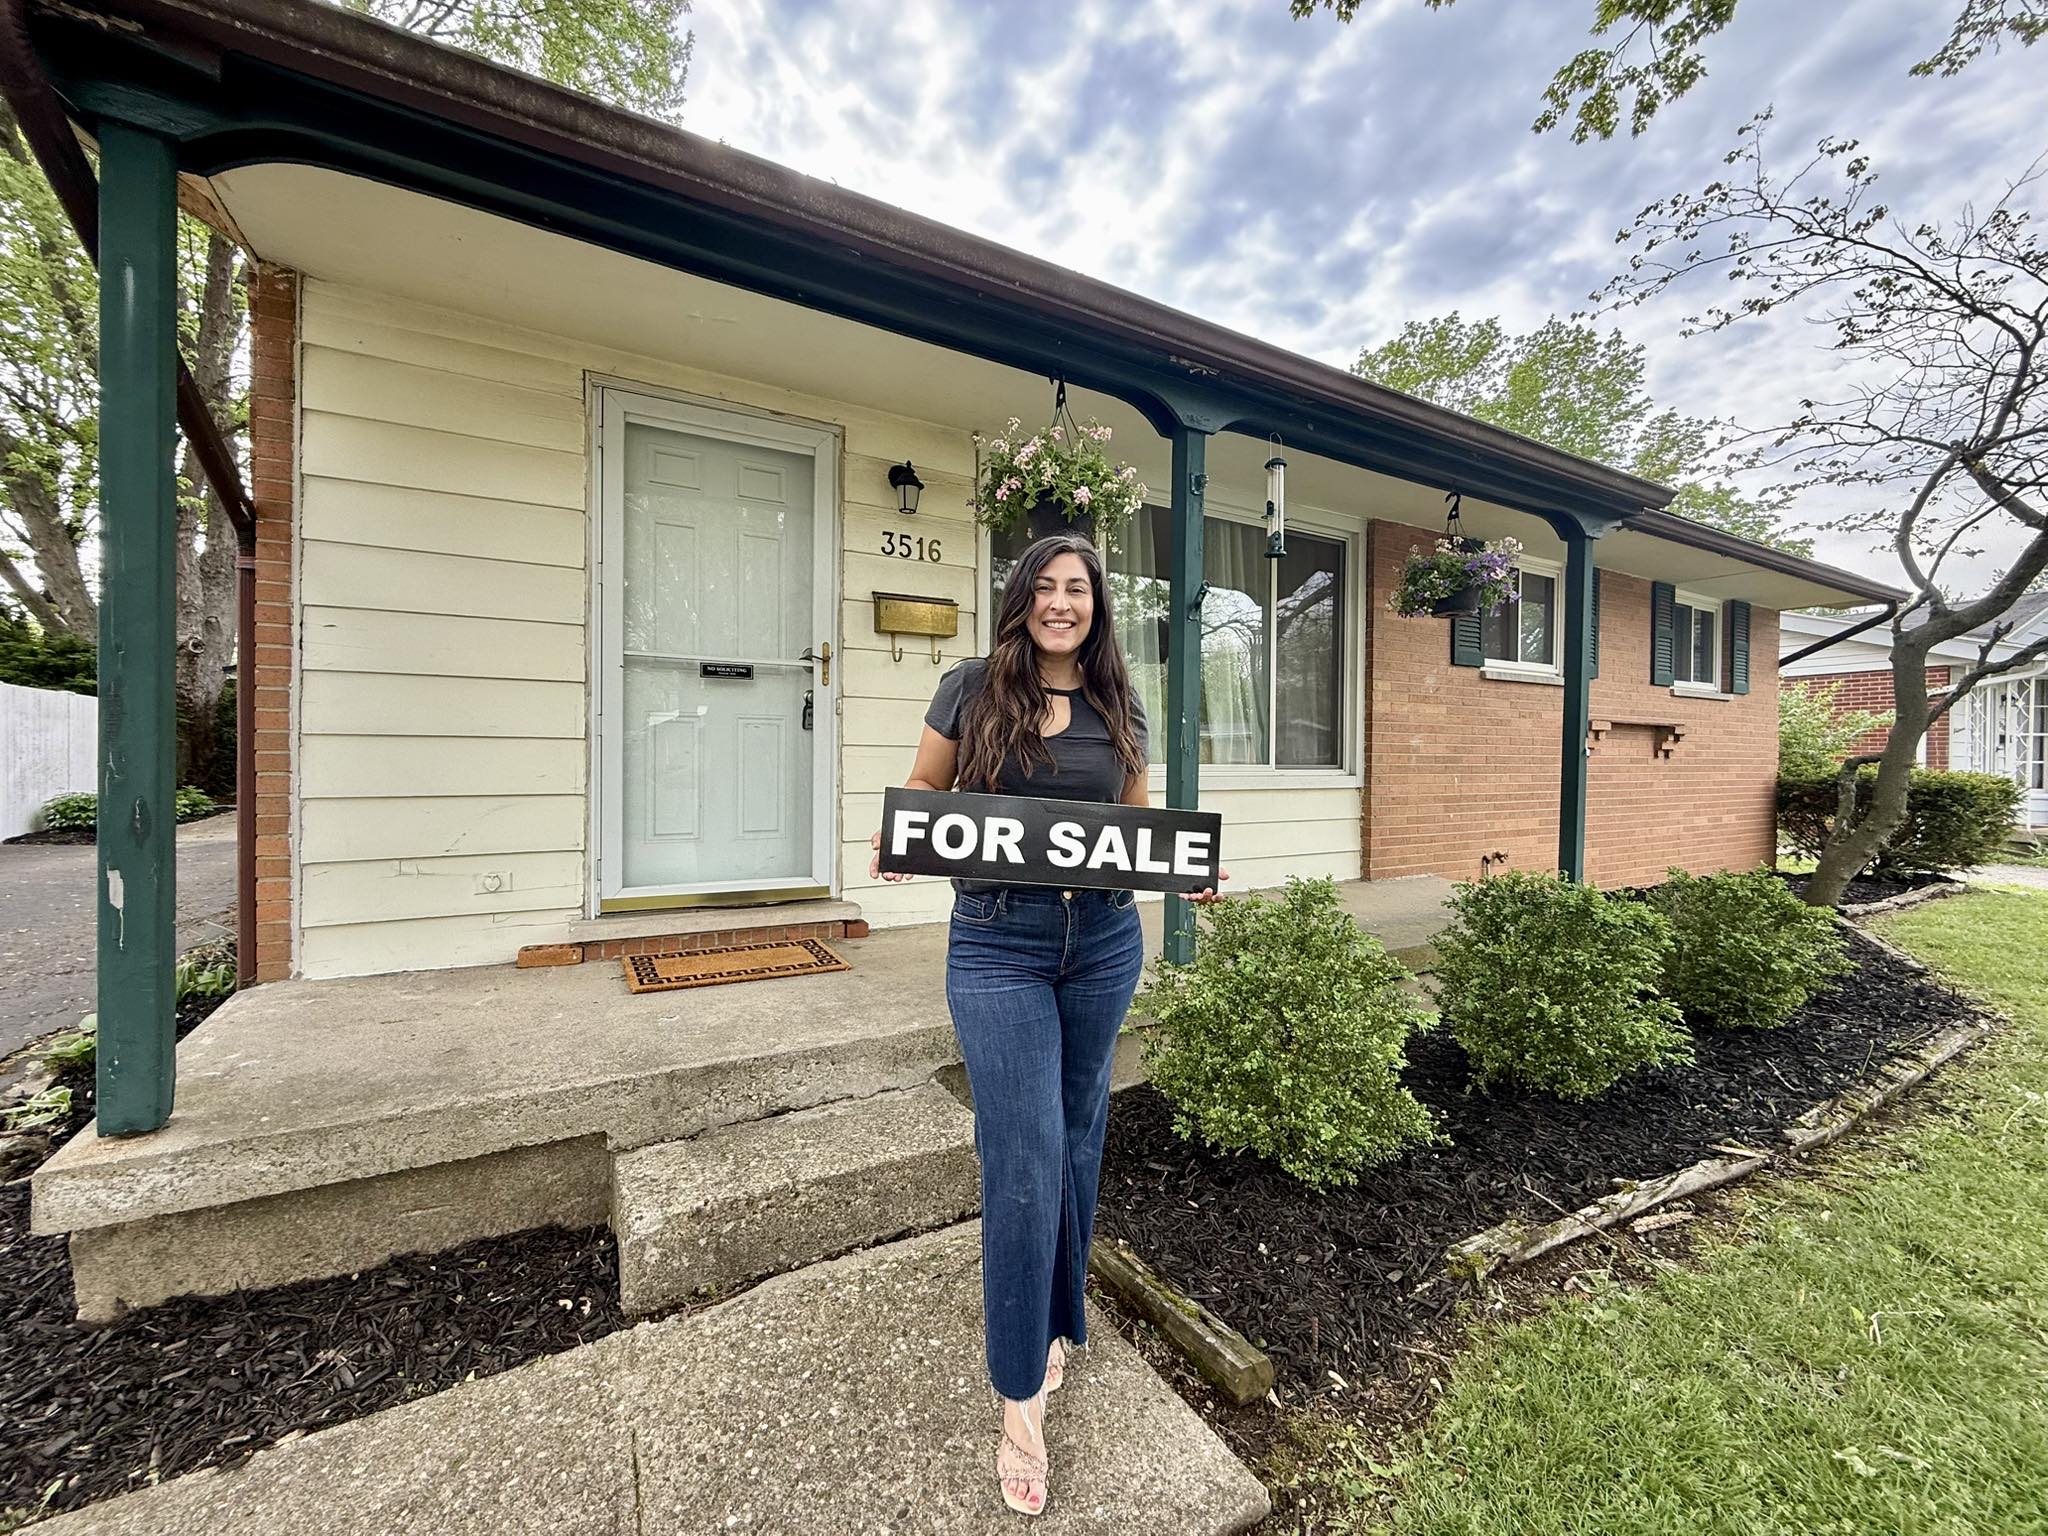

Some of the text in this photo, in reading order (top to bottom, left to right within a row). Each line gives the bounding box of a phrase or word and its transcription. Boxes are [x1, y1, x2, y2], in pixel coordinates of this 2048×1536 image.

[881, 531, 941, 562] 3516
[891, 809, 1212, 877] FOR SALE
